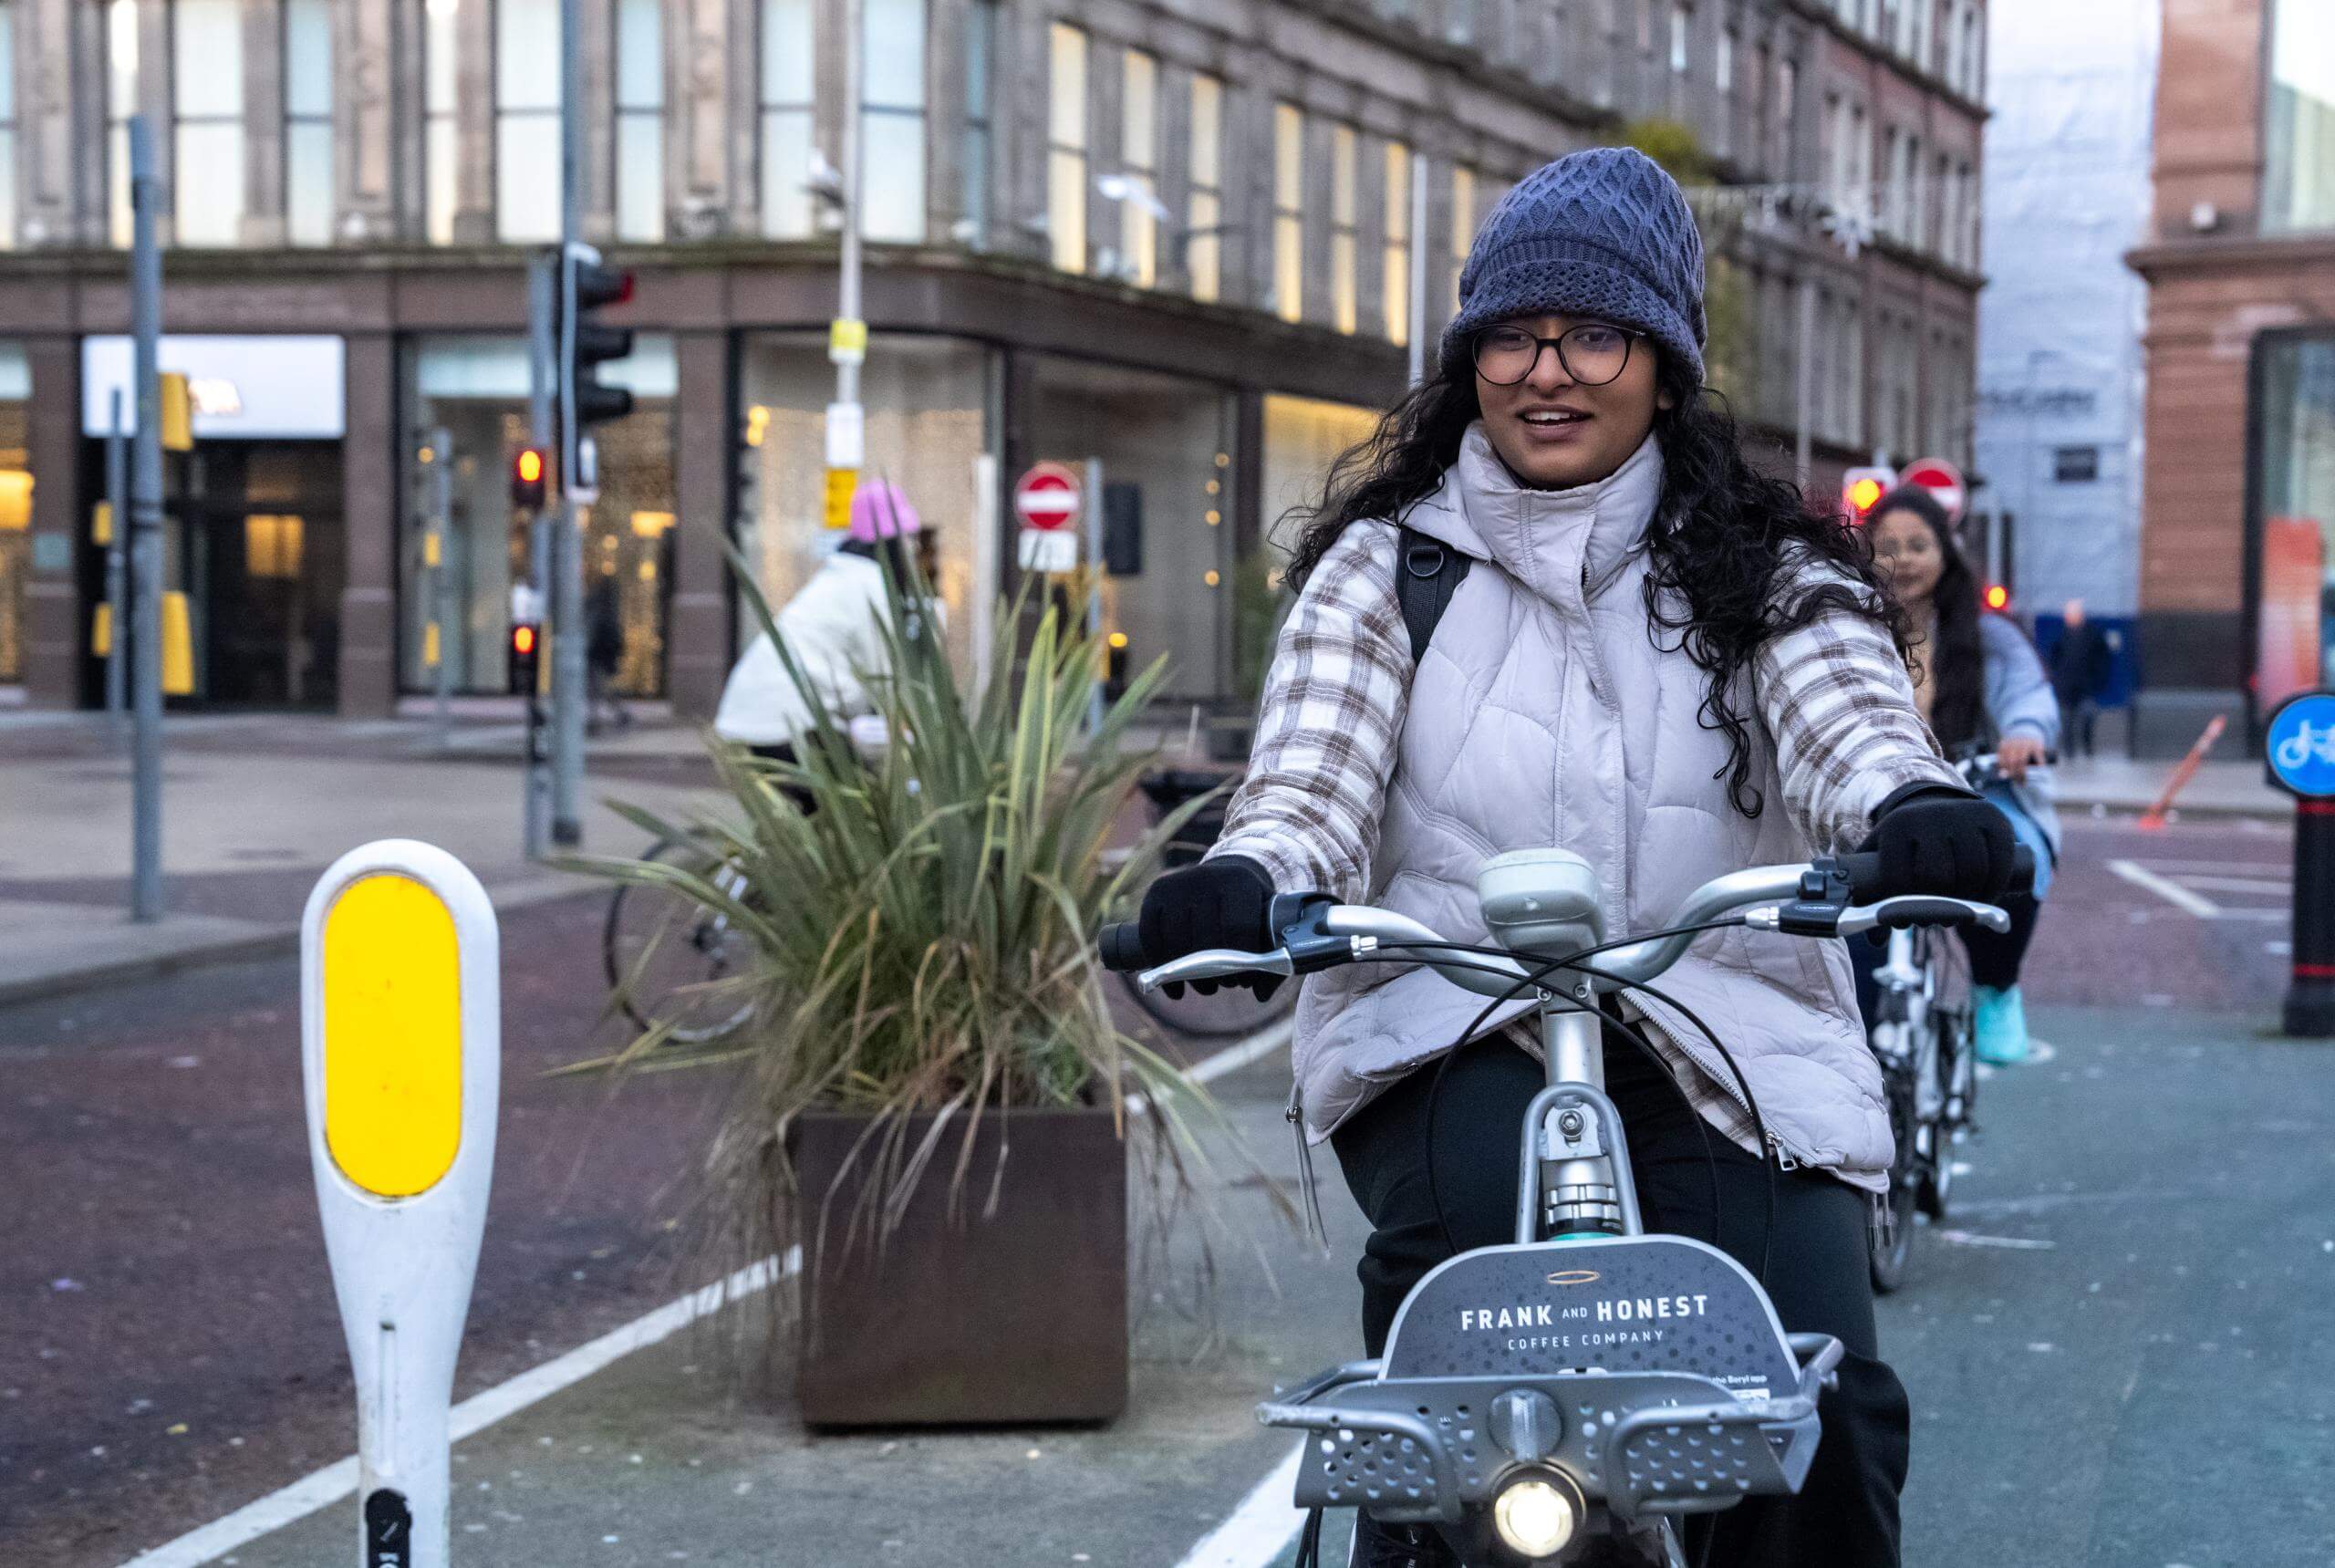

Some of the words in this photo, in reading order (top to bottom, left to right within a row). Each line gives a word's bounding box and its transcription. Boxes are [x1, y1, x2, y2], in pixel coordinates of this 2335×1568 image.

[1461, 1304, 1552, 1331] FRANK
[1562, 1306, 1588, 1319] AND
[1596, 1294, 1707, 1322] HONEST
[1508, 1335, 1570, 1350] COFFEE
[1582, 1330, 1663, 1346] COMPANY
